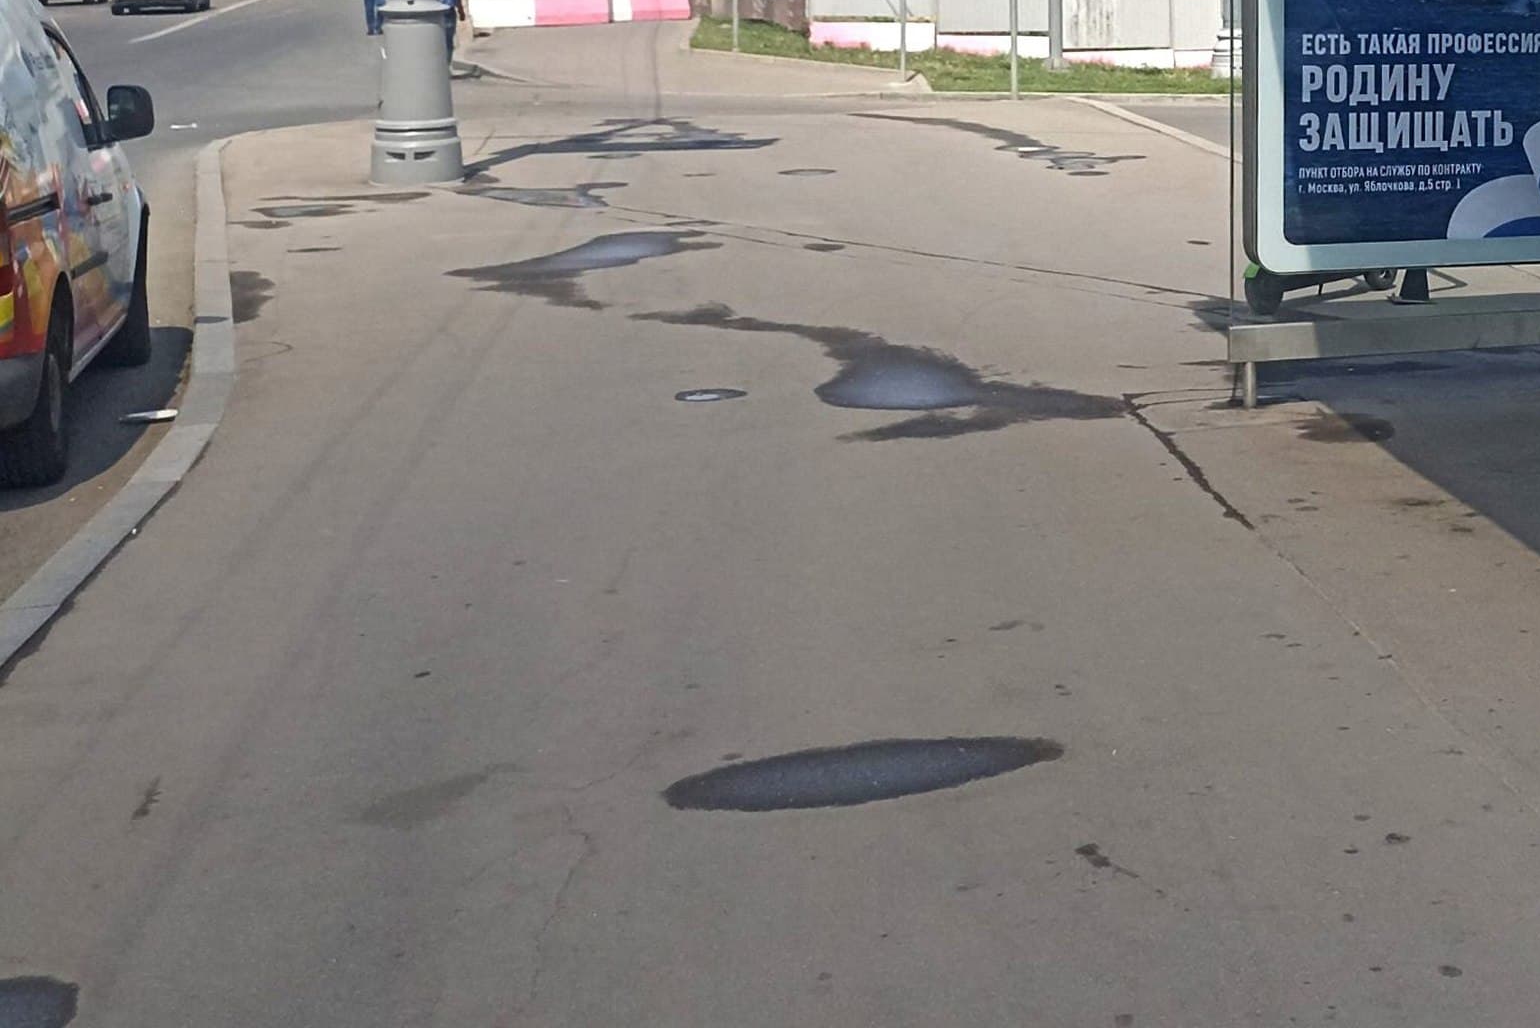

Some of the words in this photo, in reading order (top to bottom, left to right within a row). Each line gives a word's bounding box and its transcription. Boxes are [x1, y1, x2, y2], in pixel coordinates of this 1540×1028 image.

[1301, 33, 1351, 55] ЕСТЬ
[1357, 33, 1421, 54] ТАКАЯ
[1301, 64, 1455, 107] РОДИНУ
[1299, 110, 1514, 152] ЗАЩИЩАТЬ
[1299, 167, 1328, 179] ПУНКТ
[1330, 166, 1364, 178] ОТБОРА
[1366, 166, 1379, 177] НА
[1380, 165, 1416, 177] СЛУЖБУ
[1418, 164, 1430, 175] ПО
[1432, 163, 1481, 175] КОНТРАКТУ
[1308, 183, 1347, 193] Москва,
